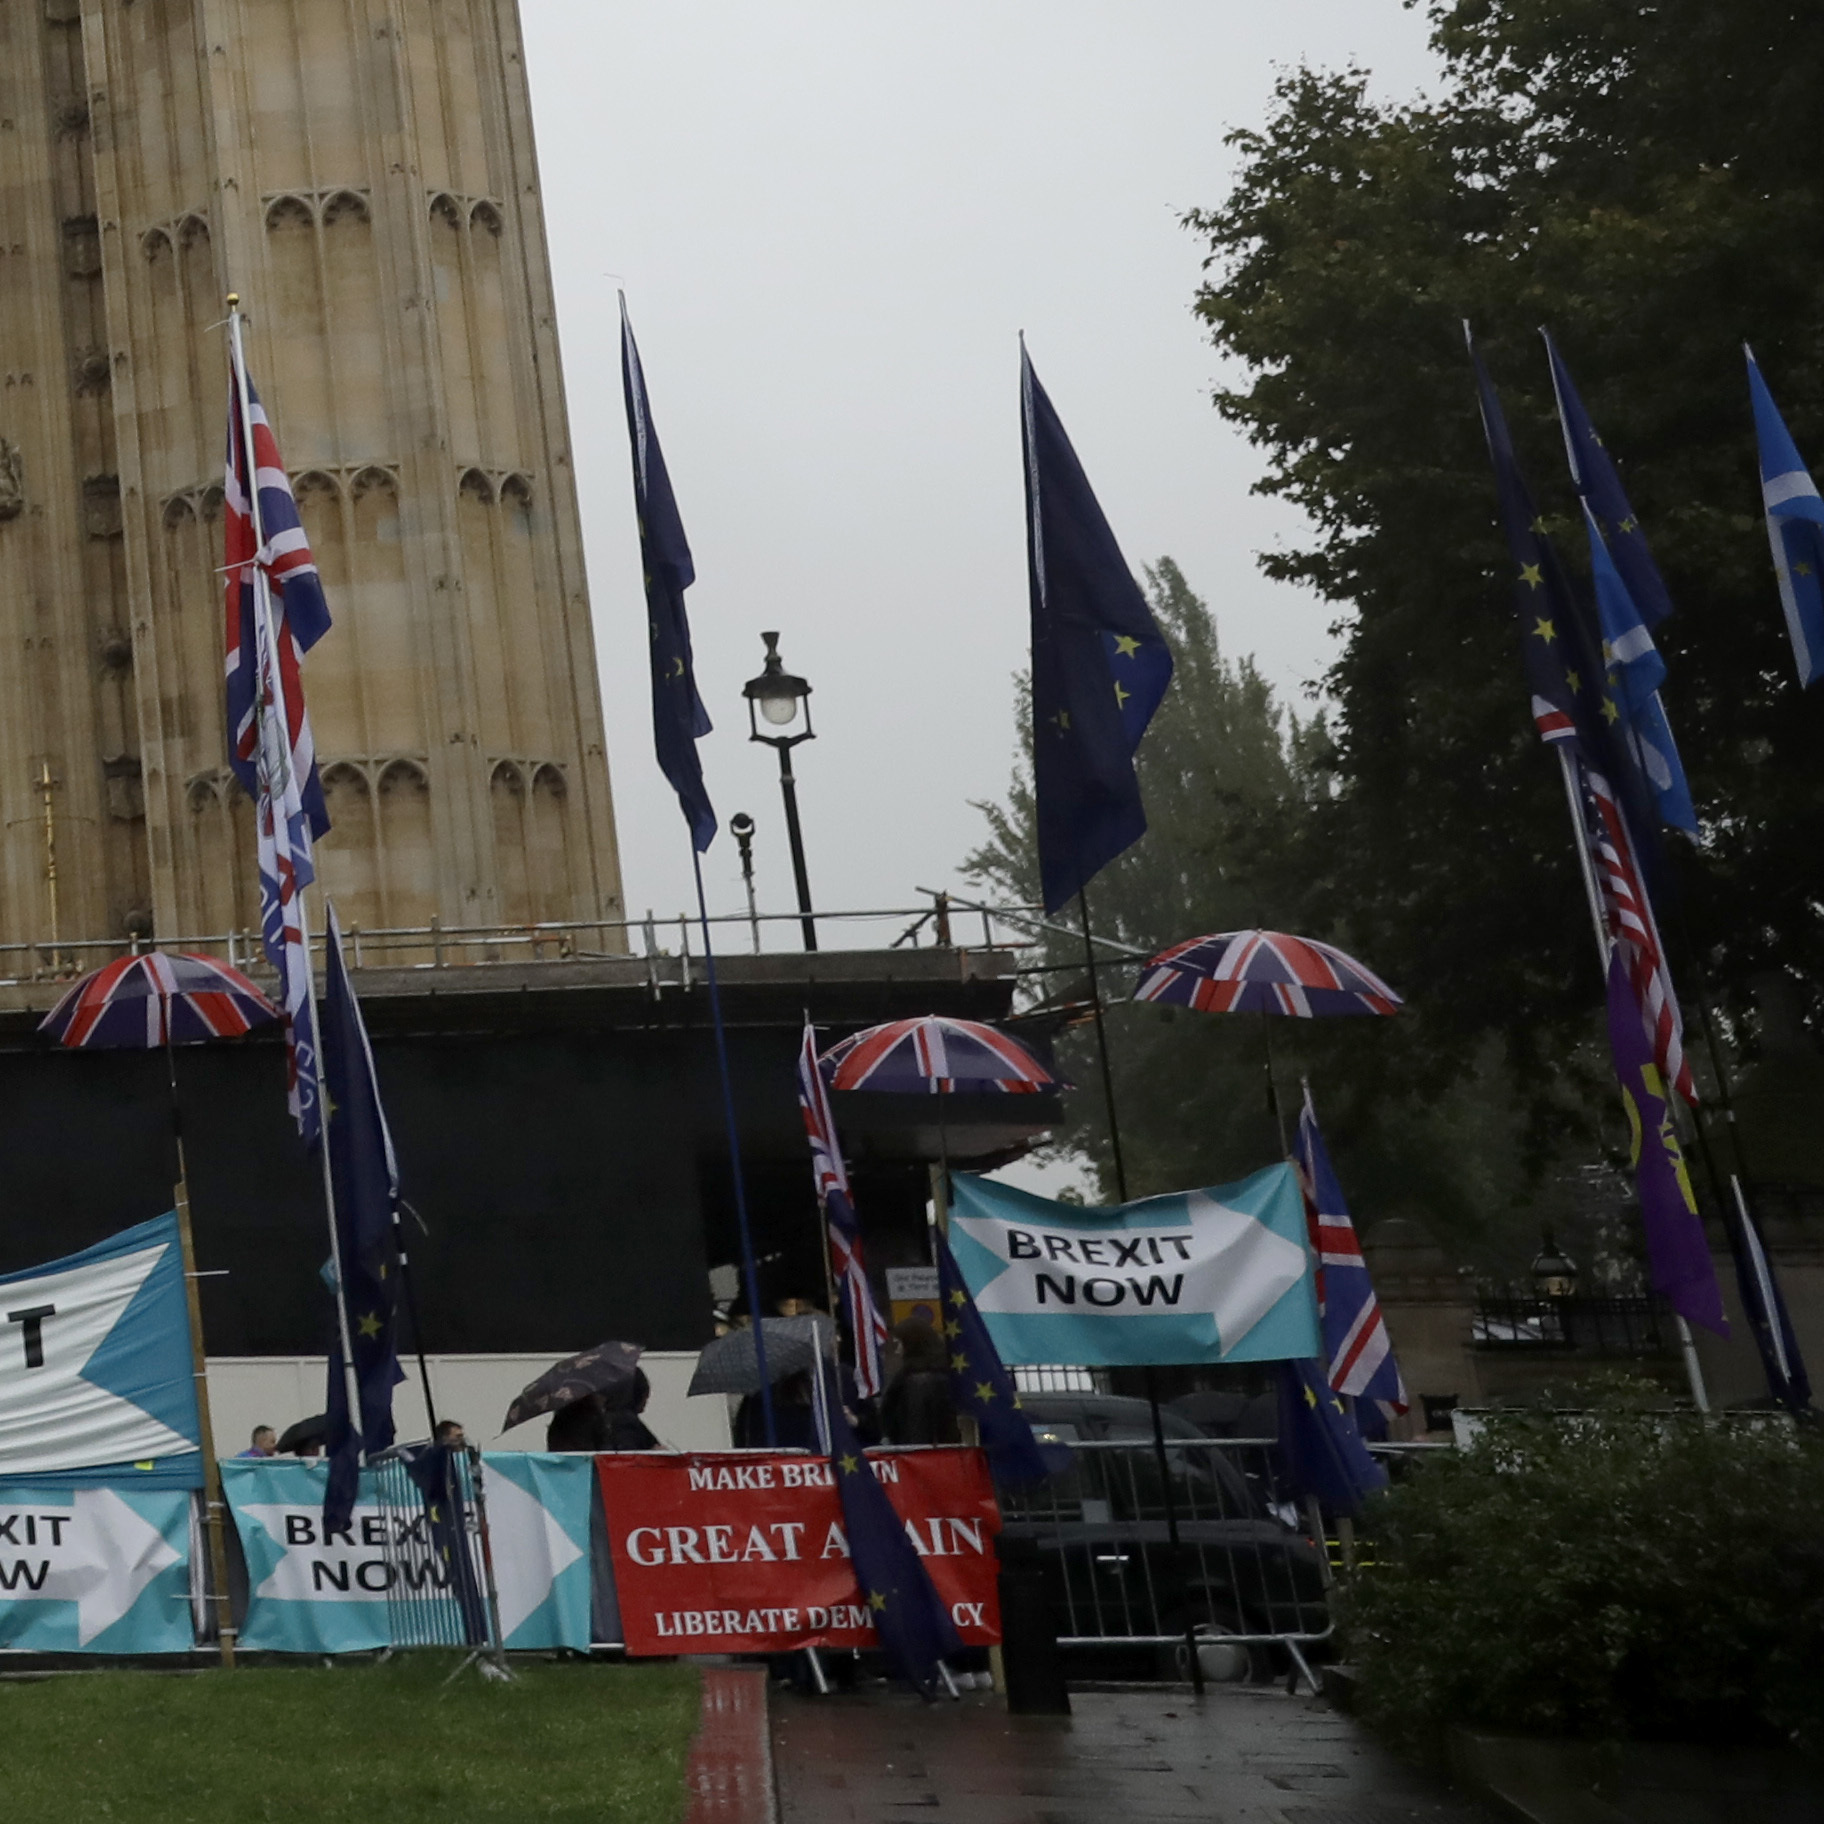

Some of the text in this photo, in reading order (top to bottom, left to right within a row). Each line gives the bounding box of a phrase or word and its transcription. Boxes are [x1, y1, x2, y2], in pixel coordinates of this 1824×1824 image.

[1007, 1229, 1193, 1267] BREXIT
[1035, 1273, 1184, 1306] NOW
[688, 1460, 900, 1491] MAKE BRIIN
[285, 1513, 474, 1547] BREX
[625, 1516, 984, 1566] GREAT AAIN
[312, 1559, 453, 1591] NOW
[655, 1602, 984, 1637] LIBERATE DEMCY
